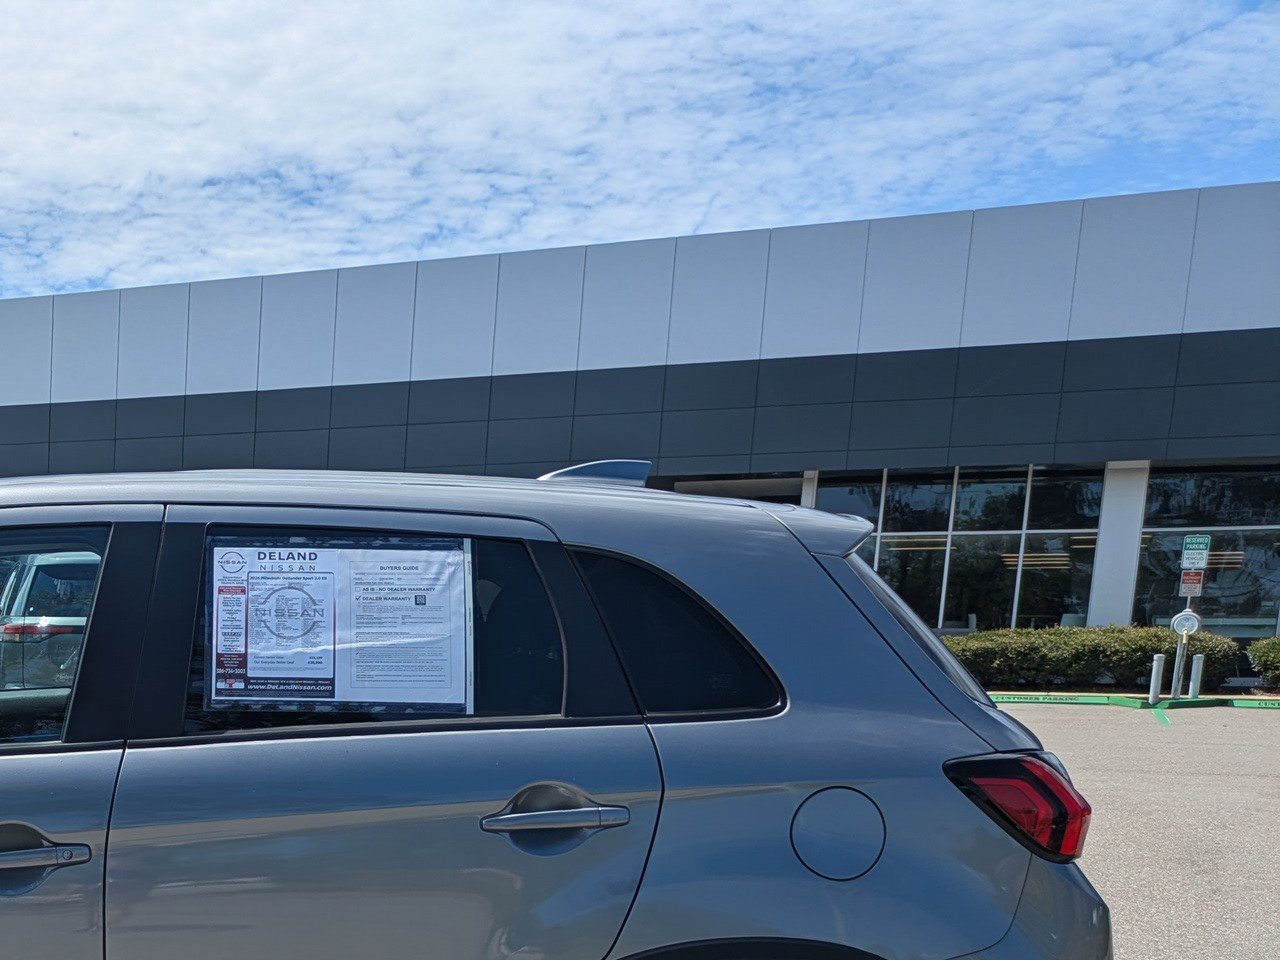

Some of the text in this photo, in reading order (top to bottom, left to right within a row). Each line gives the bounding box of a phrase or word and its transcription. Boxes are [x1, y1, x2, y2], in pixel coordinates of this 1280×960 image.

[257, 551, 318, 561] DELAND
[254, 608, 325, 618] NISSAN
[247, 683, 333, 691] www.DeLandNissan.com
